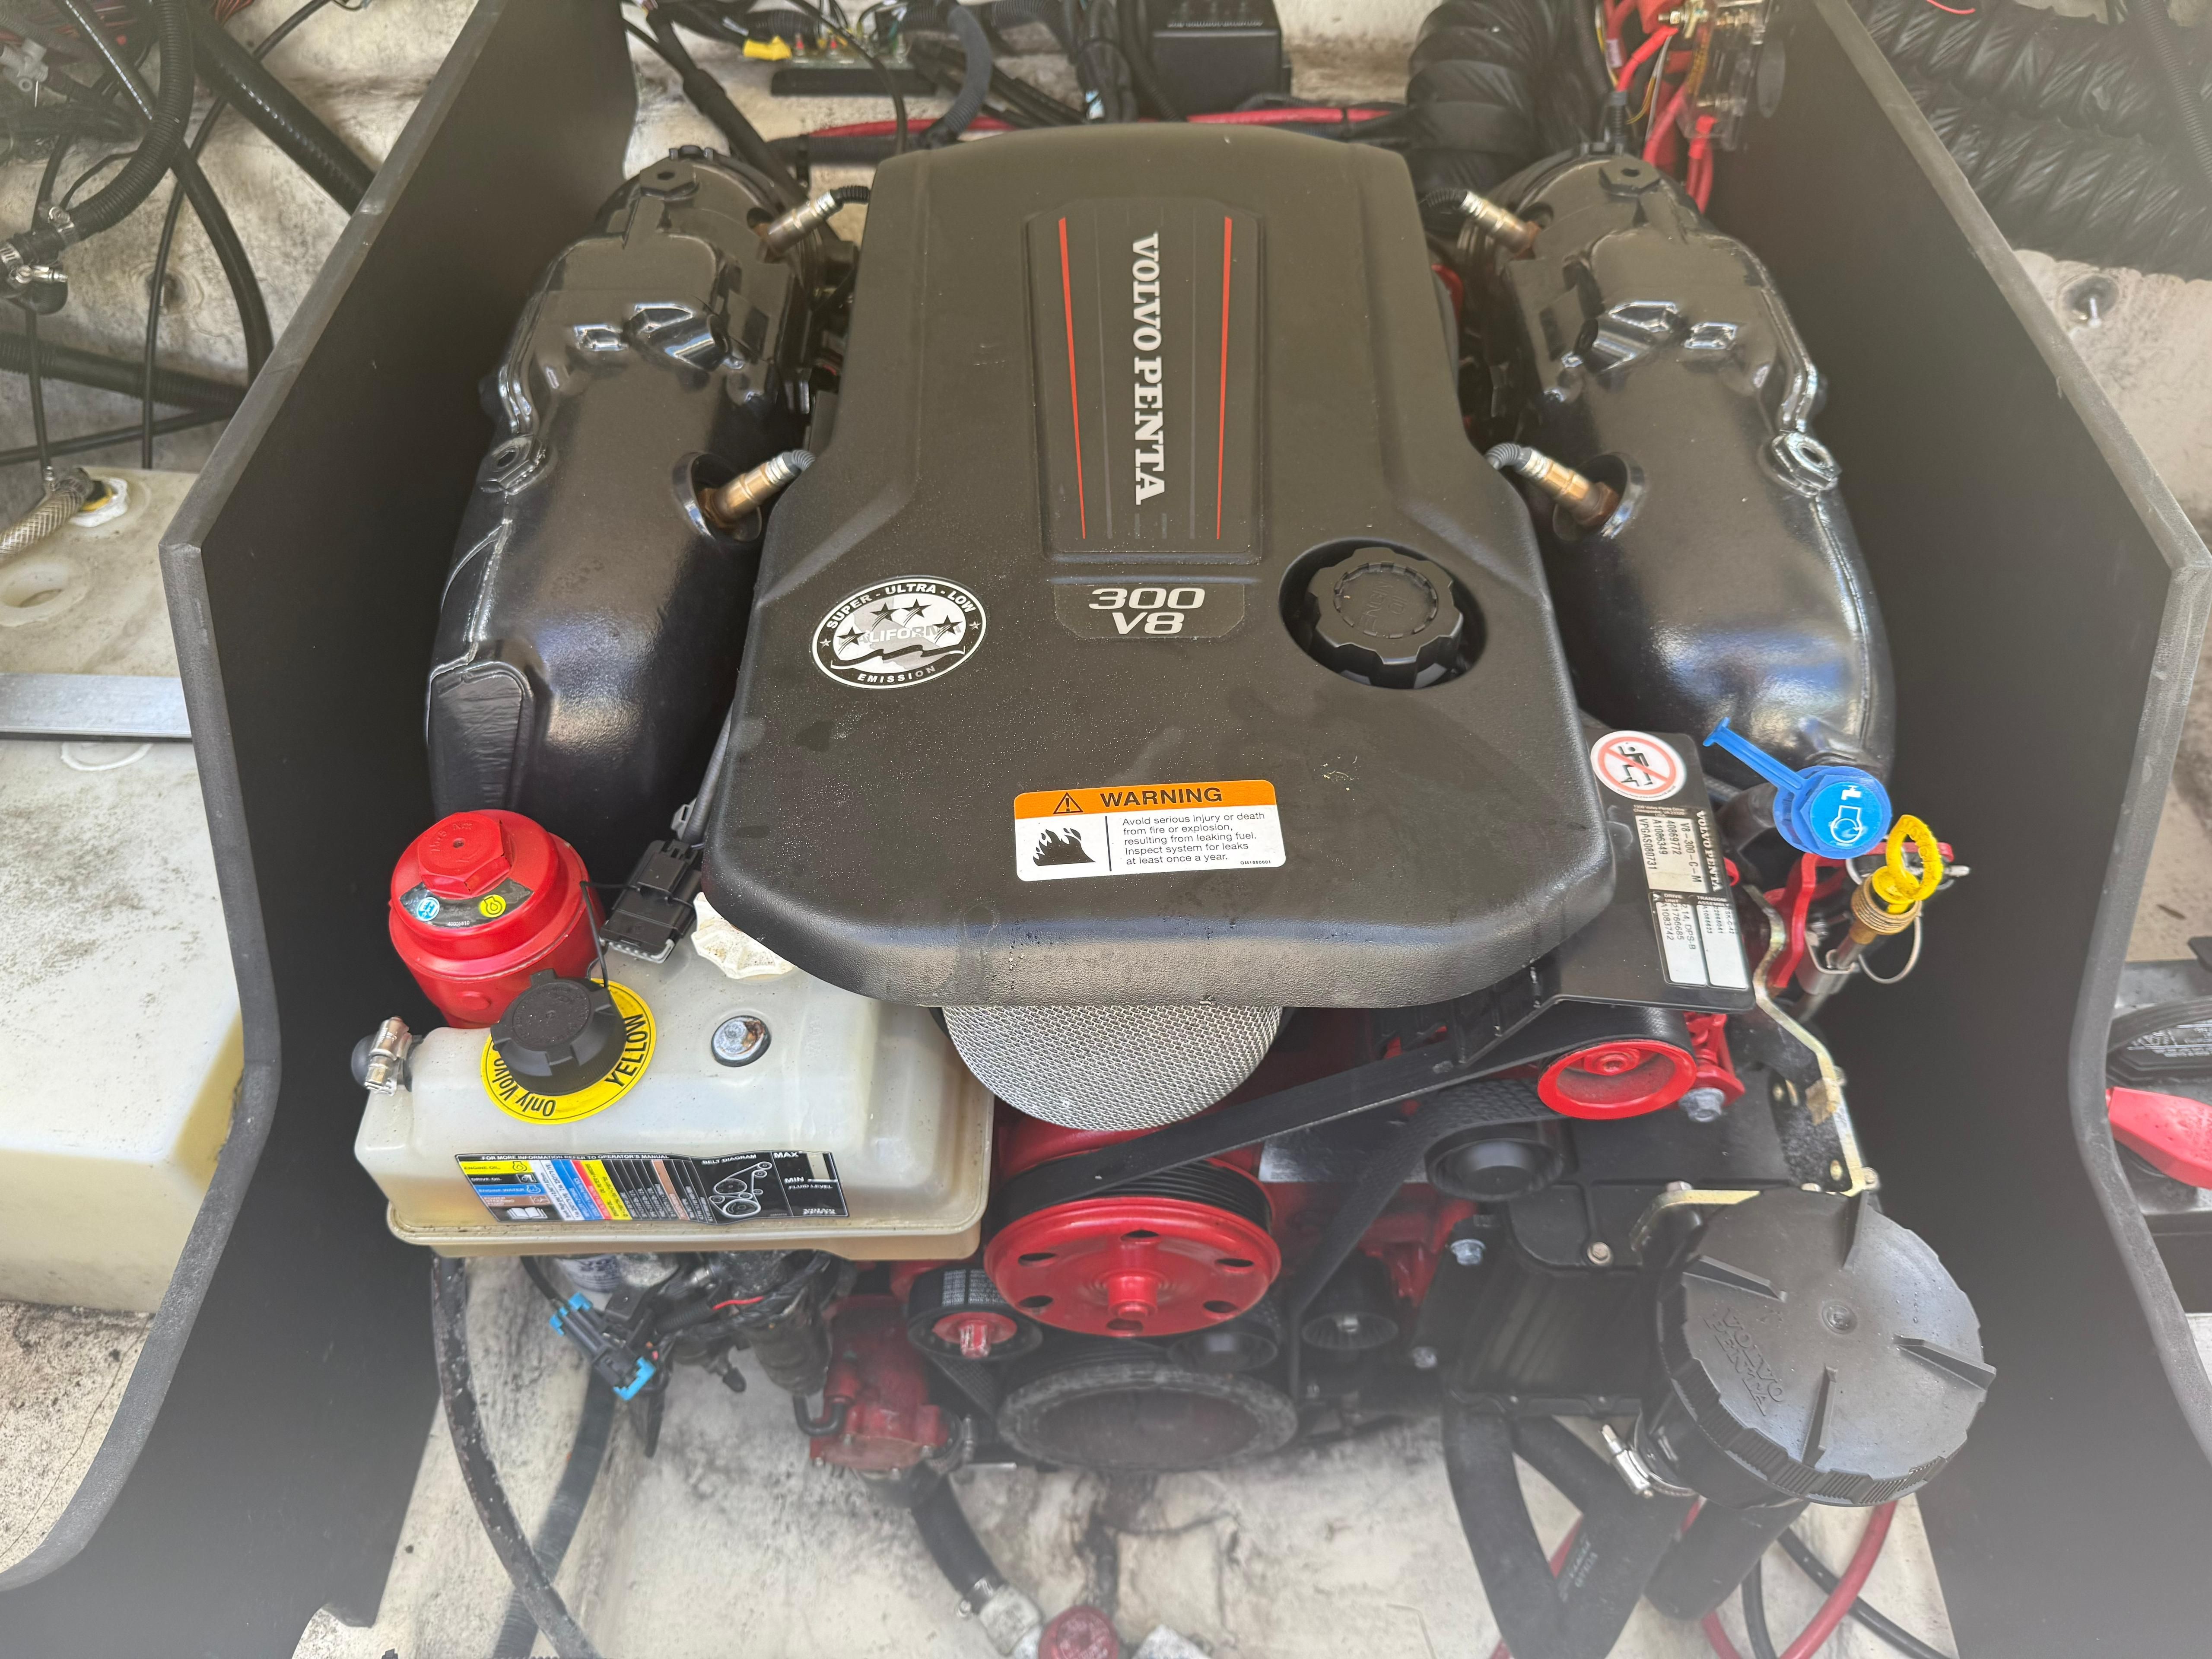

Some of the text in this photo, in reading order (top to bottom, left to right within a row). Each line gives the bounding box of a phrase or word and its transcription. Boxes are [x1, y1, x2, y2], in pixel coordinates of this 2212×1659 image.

[1132, 232, 1165, 505] VOLVO PENTA
[826, 594, 873, 629] SUPER
[885, 583, 936, 594] ULTRA
[947, 590, 976, 613] LOW
[1088, 588, 1205, 609] 300
[1112, 612, 1184, 635] V8
[857, 665, 935, 683] EMISSION
[1100, 787, 1222, 807] WARNING
[1122, 817, 1150, 826] Avoid
[1154, 815, 1190, 824] serious
[1237, 812, 1265, 820] death
[1123, 827, 1146, 836] from
[1150, 826, 1165, 834] fire
[1182, 823, 1233, 833] explosion,
[1124, 832, 1257, 846] resulting from leaking fuel.
[1125, 842, 1249, 855] Inspect system for leaks
[1639, 818, 1657, 870] VPGAS080731
[1652, 819, 1668, 855] A1086349
[1666, 820, 1682, 855] 40869772
[1697, 810, 1723, 892] VOLVO PENTA
[1139, 855, 1163, 864] least
[1204, 853, 1228, 862] year.
[1660, 903, 1674, 941] A1083742
[1671, 903, 1684, 940] 21766685
[1684, 924, 1696, 950] DPS-B
[605, 1014, 647, 1088] YELLOW
[492, 1058, 556, 1116] Only Volvo
[722, 1154, 757, 1163] DIAGRAM
[1703, 1314, 1767, 1417] PENTA
[1722, 1309, 1785, 1403] VOLVO
